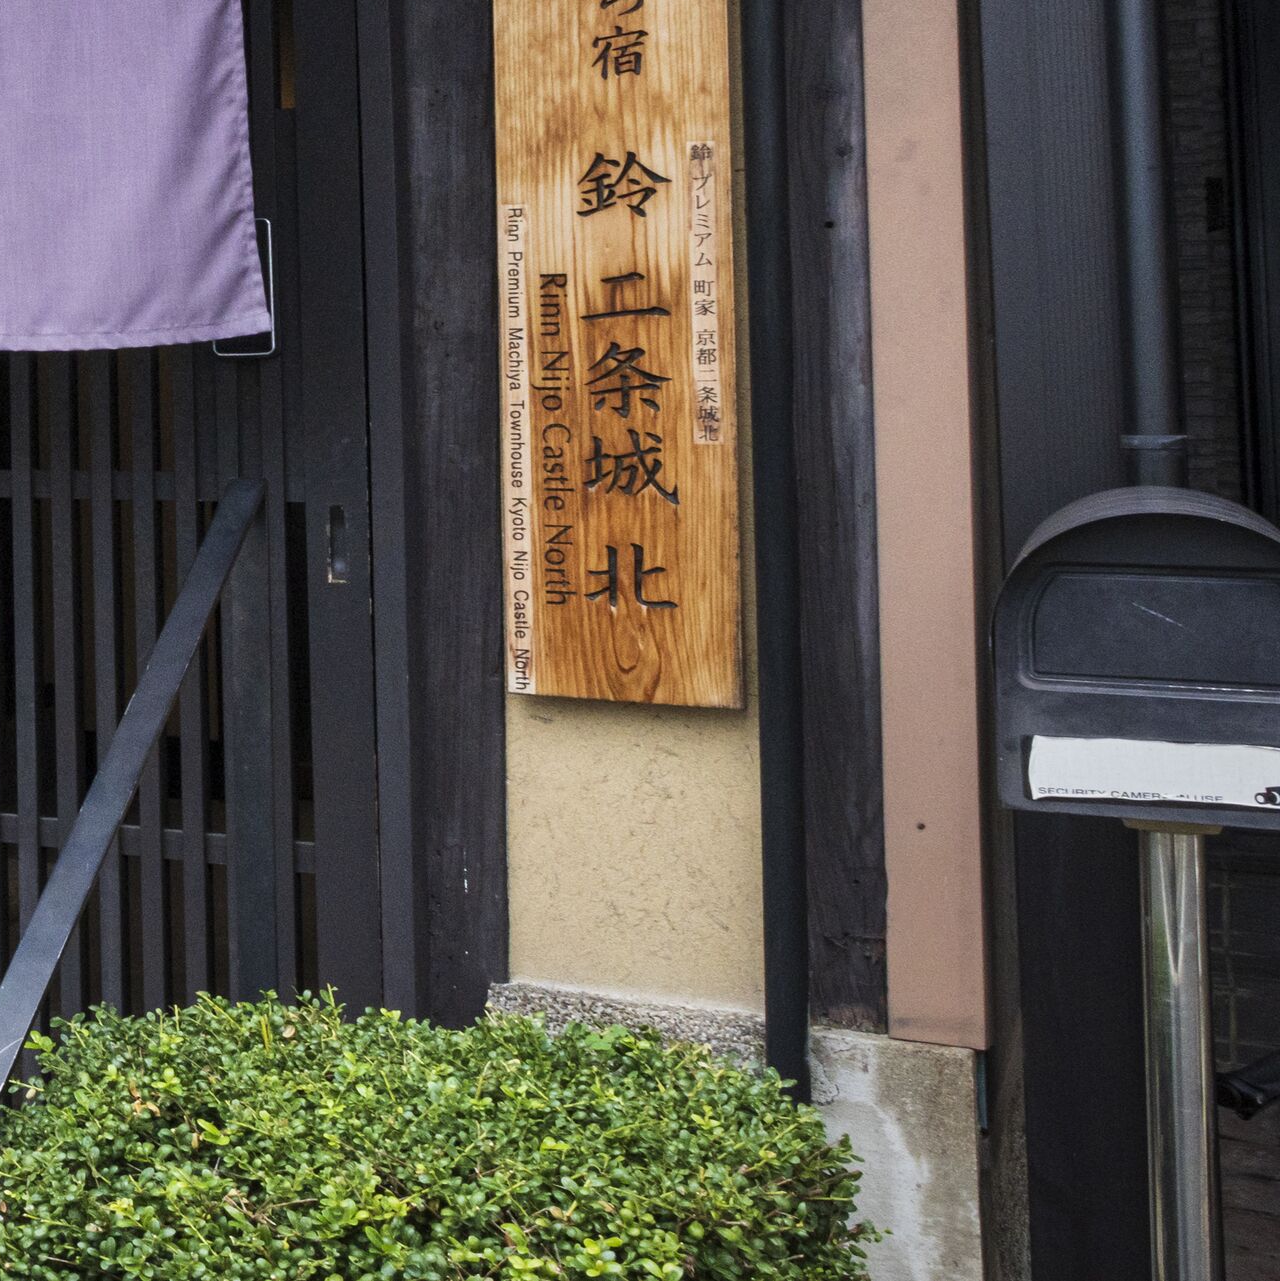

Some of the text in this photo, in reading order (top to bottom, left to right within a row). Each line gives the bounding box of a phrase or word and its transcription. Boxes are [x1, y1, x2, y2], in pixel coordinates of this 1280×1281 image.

[576, 151, 672, 218] 鈴
[690, 143, 721, 442] 鈴 プレミアム 町家 京都二条城北
[506, 208, 530, 690] Rinn Premium Machiya Townhouse Kyoto Nijo Castle North
[531, 273, 576, 605] Rinn Nijo Castle North
